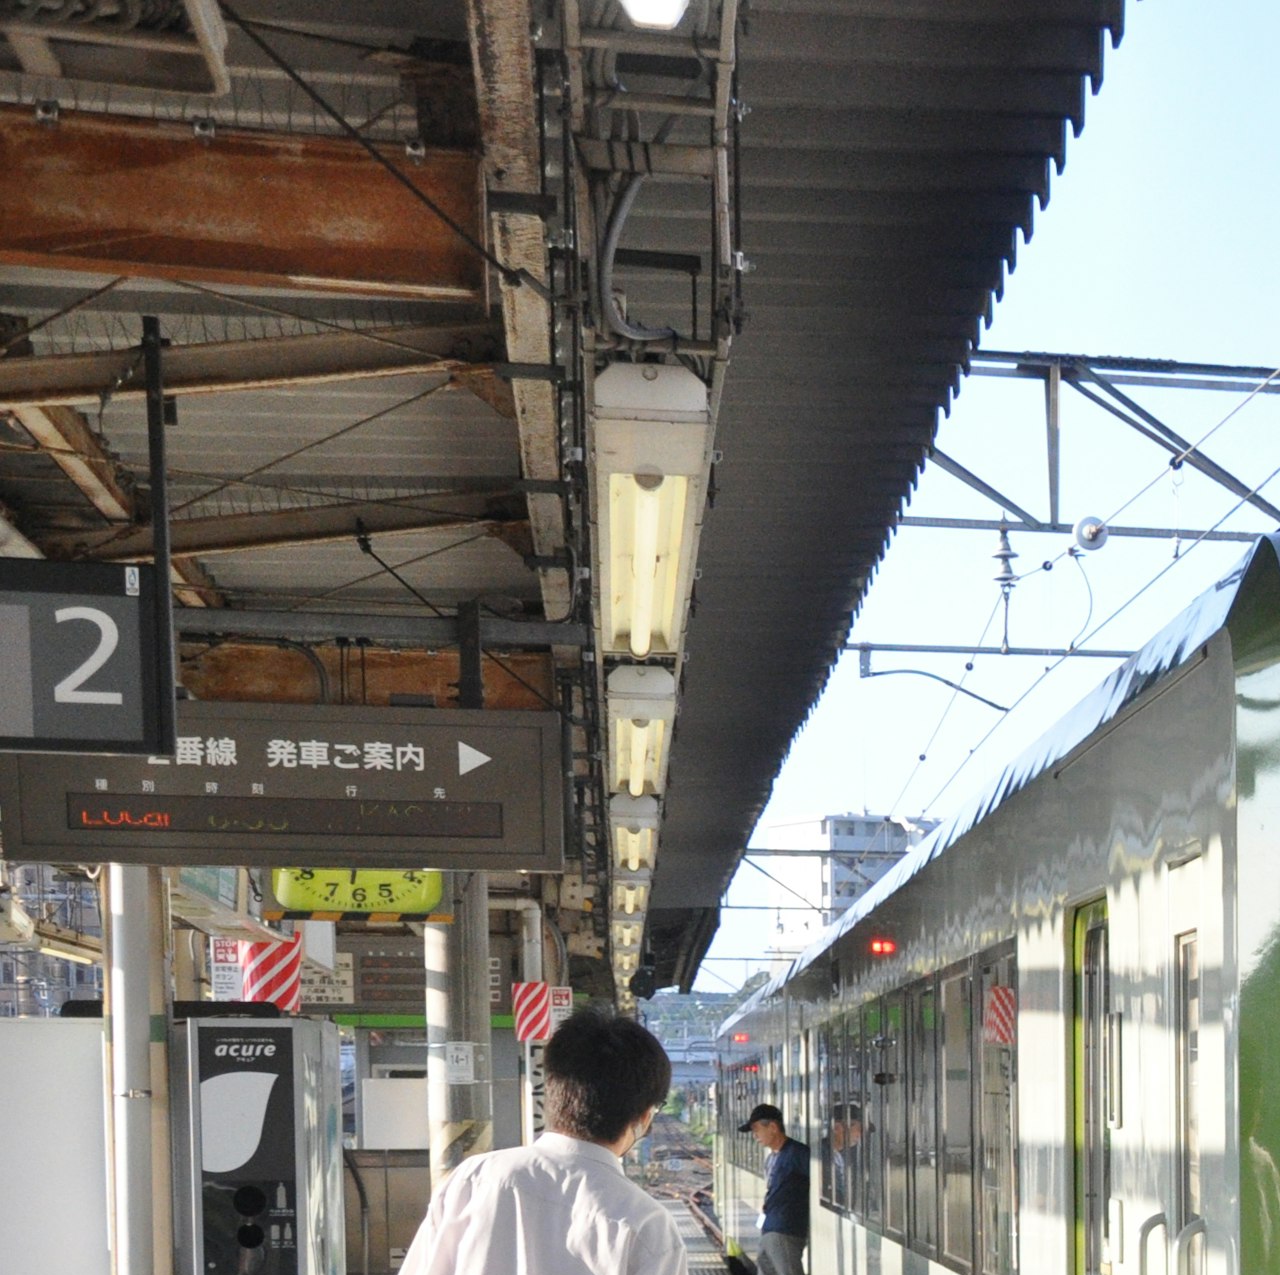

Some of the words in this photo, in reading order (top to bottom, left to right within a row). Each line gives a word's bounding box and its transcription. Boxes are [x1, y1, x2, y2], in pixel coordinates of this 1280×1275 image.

[52, 604, 124, 706] 2
[147, 736, 239, 767] 番線
[266, 738, 426, 773] 発車ご案内
[325, 882, 340, 897] 7
[351, 887, 367, 903] 6
[378, 883, 393, 899] 5
[214, 1044, 277, 1057] acure
